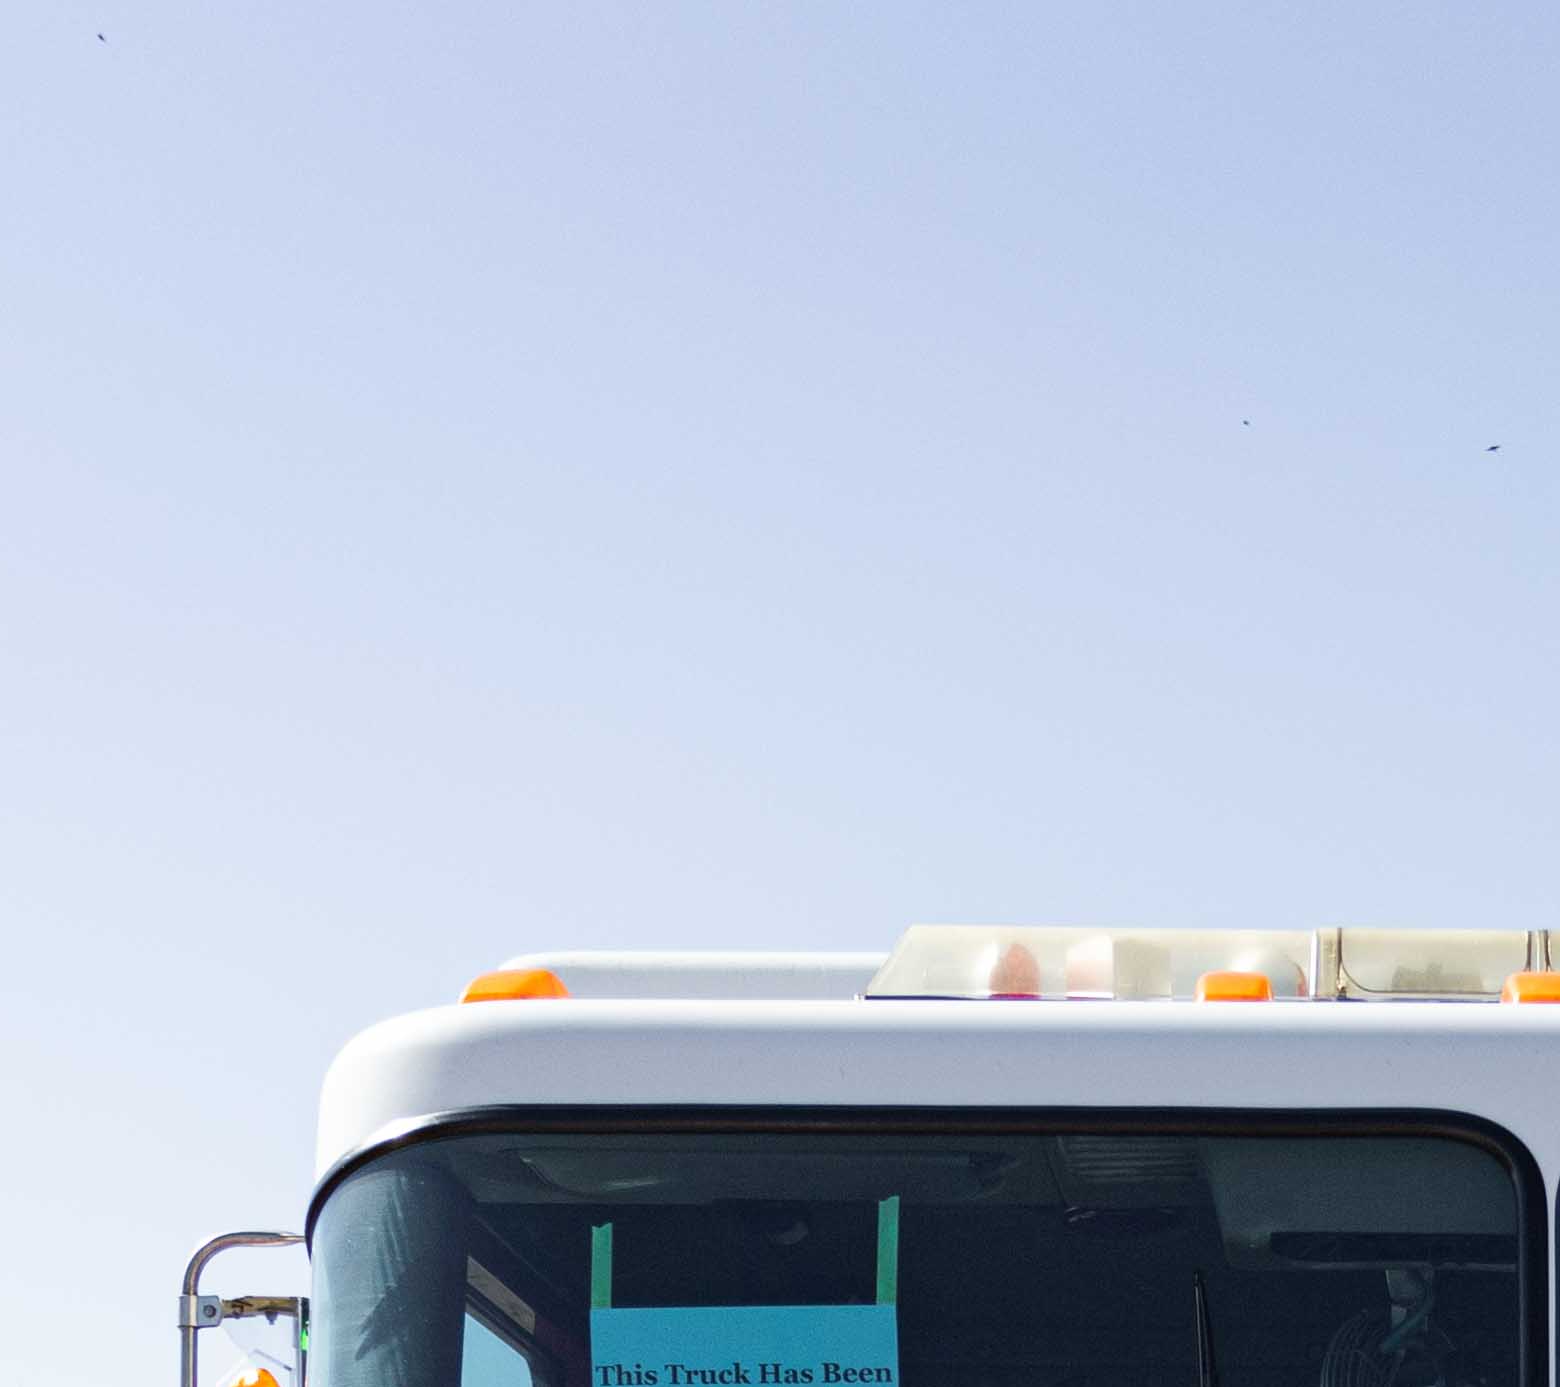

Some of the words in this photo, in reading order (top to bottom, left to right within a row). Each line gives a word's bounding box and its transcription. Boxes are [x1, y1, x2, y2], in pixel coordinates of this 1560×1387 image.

[595, 1364, 658, 1386] This
[664, 1362, 751, 1385] Truck
[758, 1362, 814, 1384] Has
[821, 1361, 893, 1384] Been
